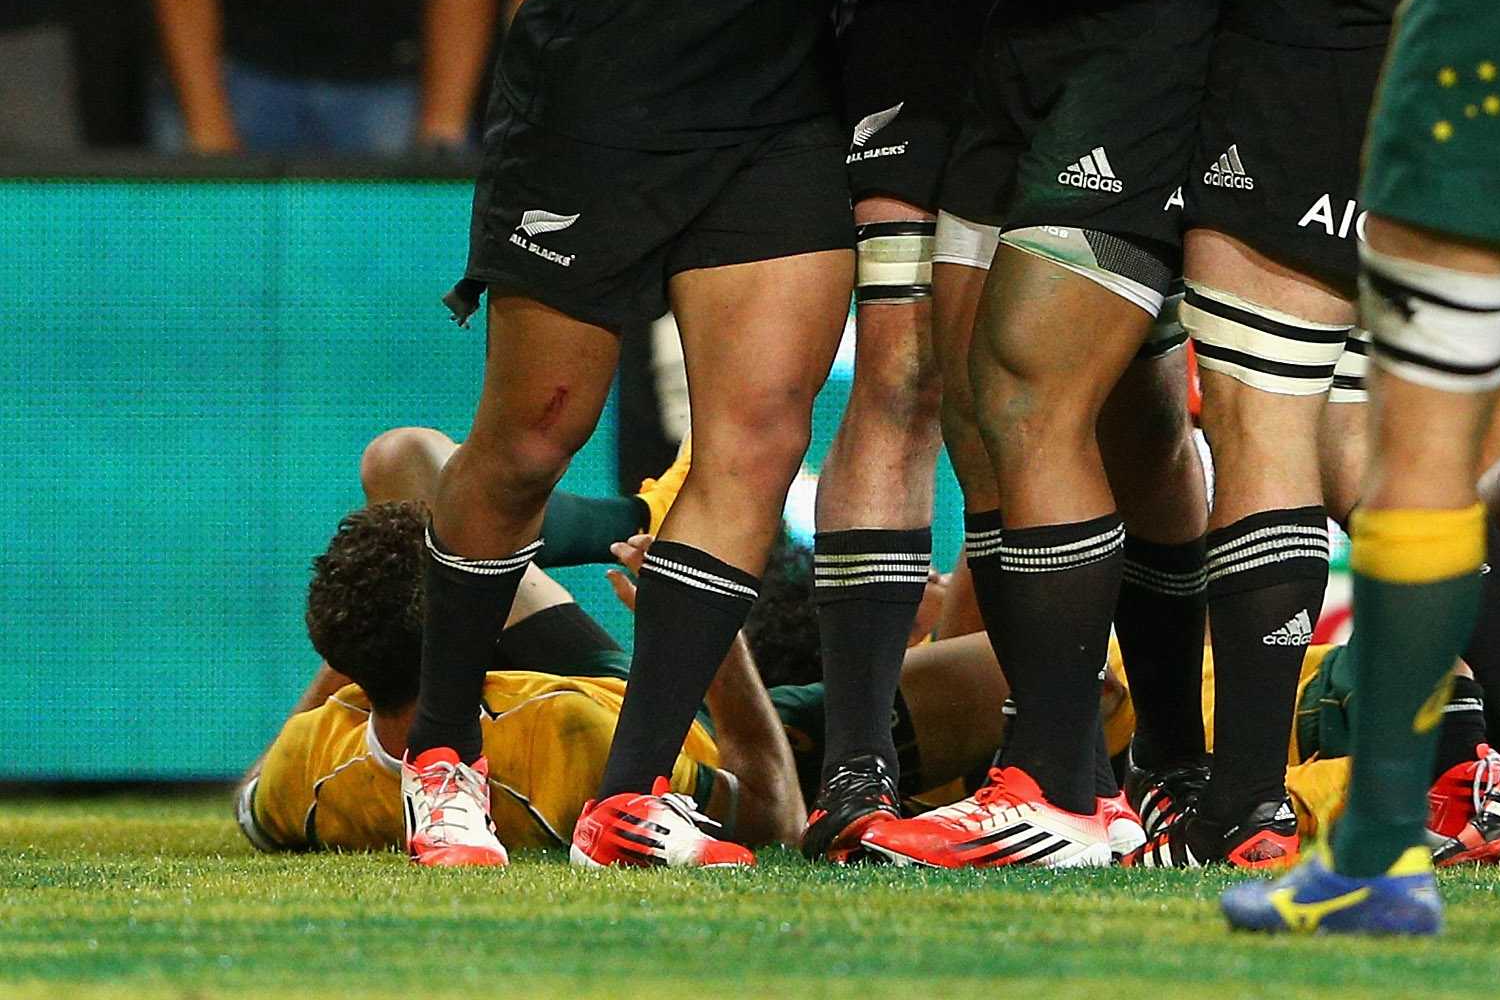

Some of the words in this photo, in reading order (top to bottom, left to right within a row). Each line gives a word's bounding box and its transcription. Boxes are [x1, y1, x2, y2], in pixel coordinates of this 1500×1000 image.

[1057, 171, 1123, 193] adidas
[1203, 171, 1254, 190] adidas
[509, 233, 527, 249] ALL
[528, 242, 571, 267] BLACKS
[1263, 634, 1313, 646] adida
